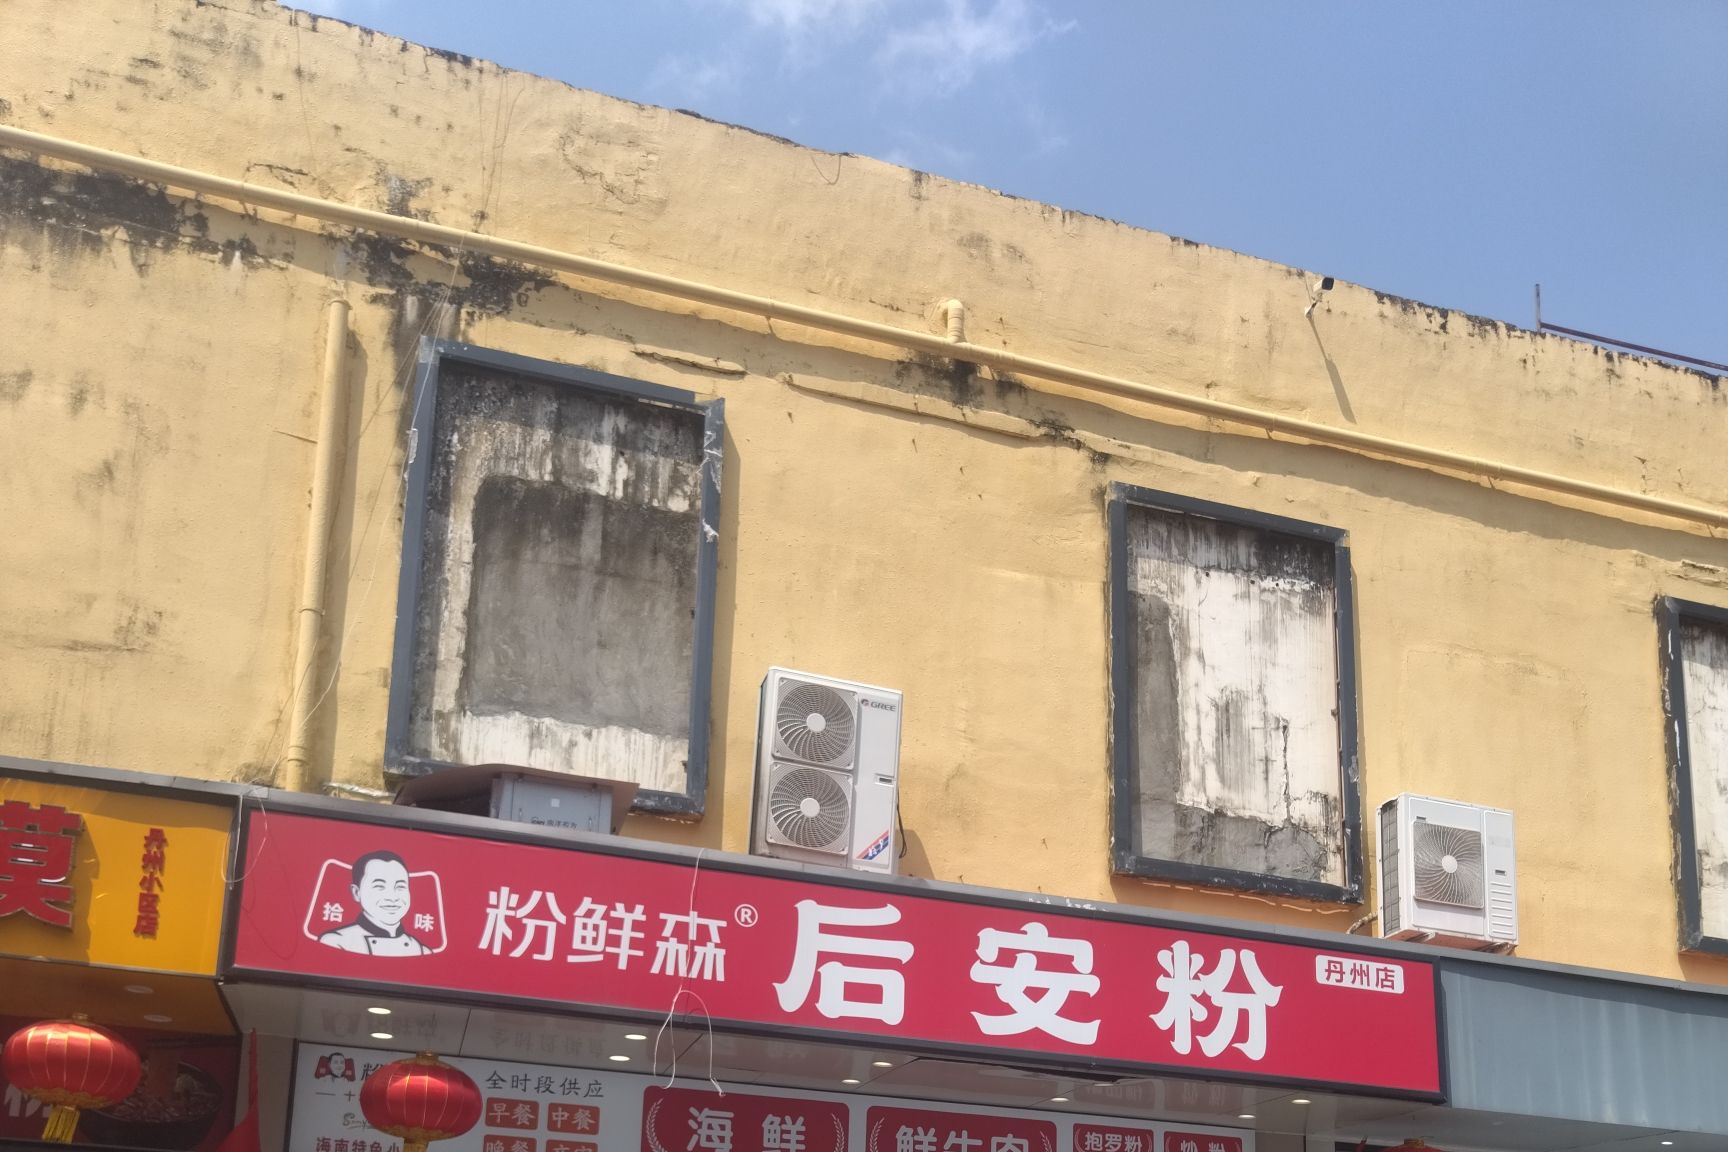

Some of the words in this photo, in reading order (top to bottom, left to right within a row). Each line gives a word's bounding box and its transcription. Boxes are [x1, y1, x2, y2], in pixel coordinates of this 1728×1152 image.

[870, 701, 896, 712] GREE
[133, 828, 169, 939] 丹州小区店
[322, 901, 345, 923] 拾
[414, 913, 435, 932] 味
[478, 885, 728, 983] 粉鲜森
[773, 898, 1283, 1061] 后安粉
[1324, 959, 1396, 991] 丹州店
[486, 1070, 605, 1098] 全时段供应
[489, 1103, 536, 1126] 早餐
[552, 1107, 596, 1130] 中餐
